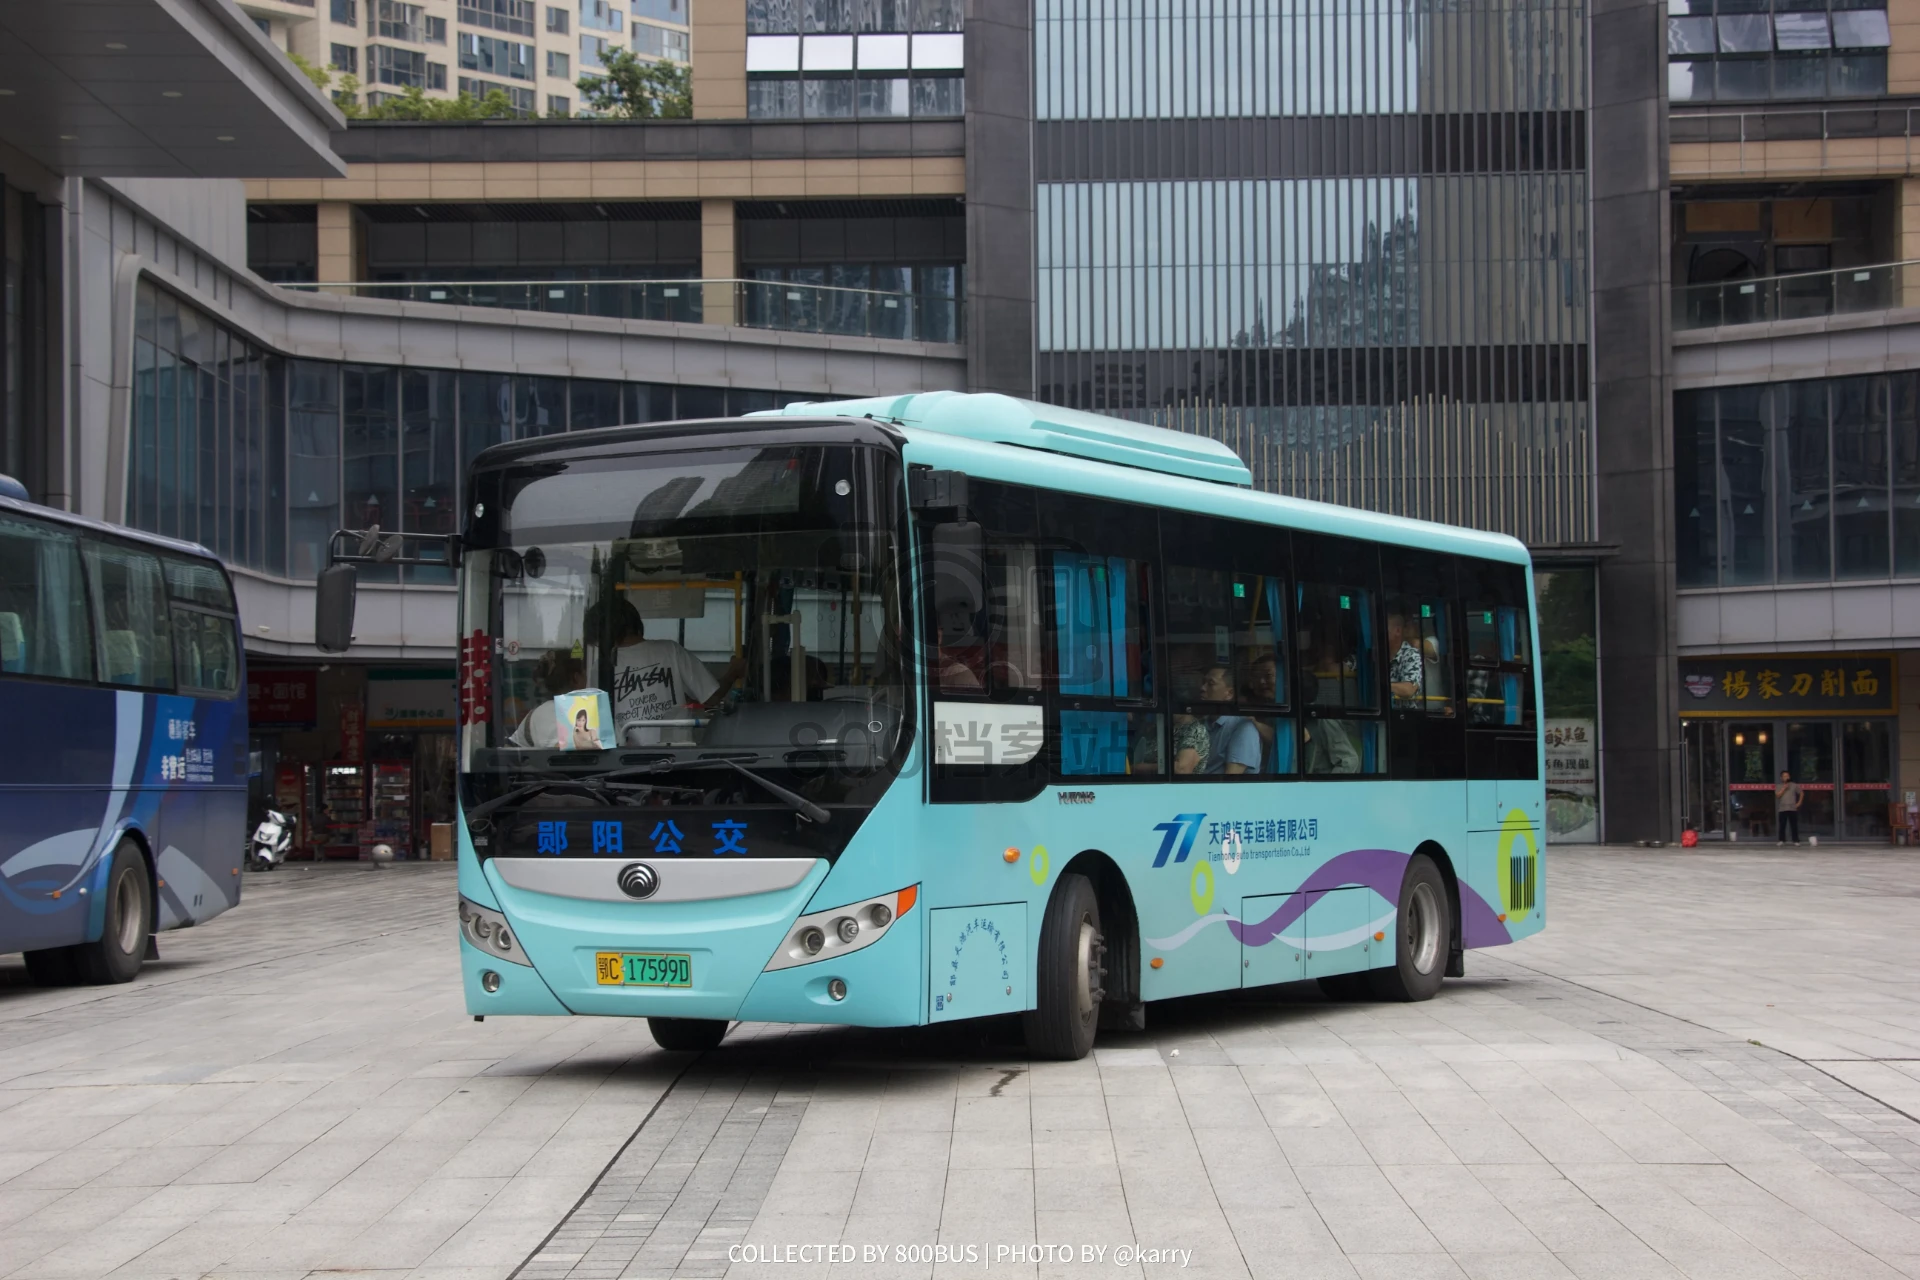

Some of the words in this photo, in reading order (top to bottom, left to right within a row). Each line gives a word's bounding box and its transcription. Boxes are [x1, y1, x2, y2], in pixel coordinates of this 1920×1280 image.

[1721, 668, 1879, 700] 楊家刀削面
[537, 819, 749, 855] 郧阳公交
[1208, 818, 1318, 846] 天鸿汽车运输有限公司
